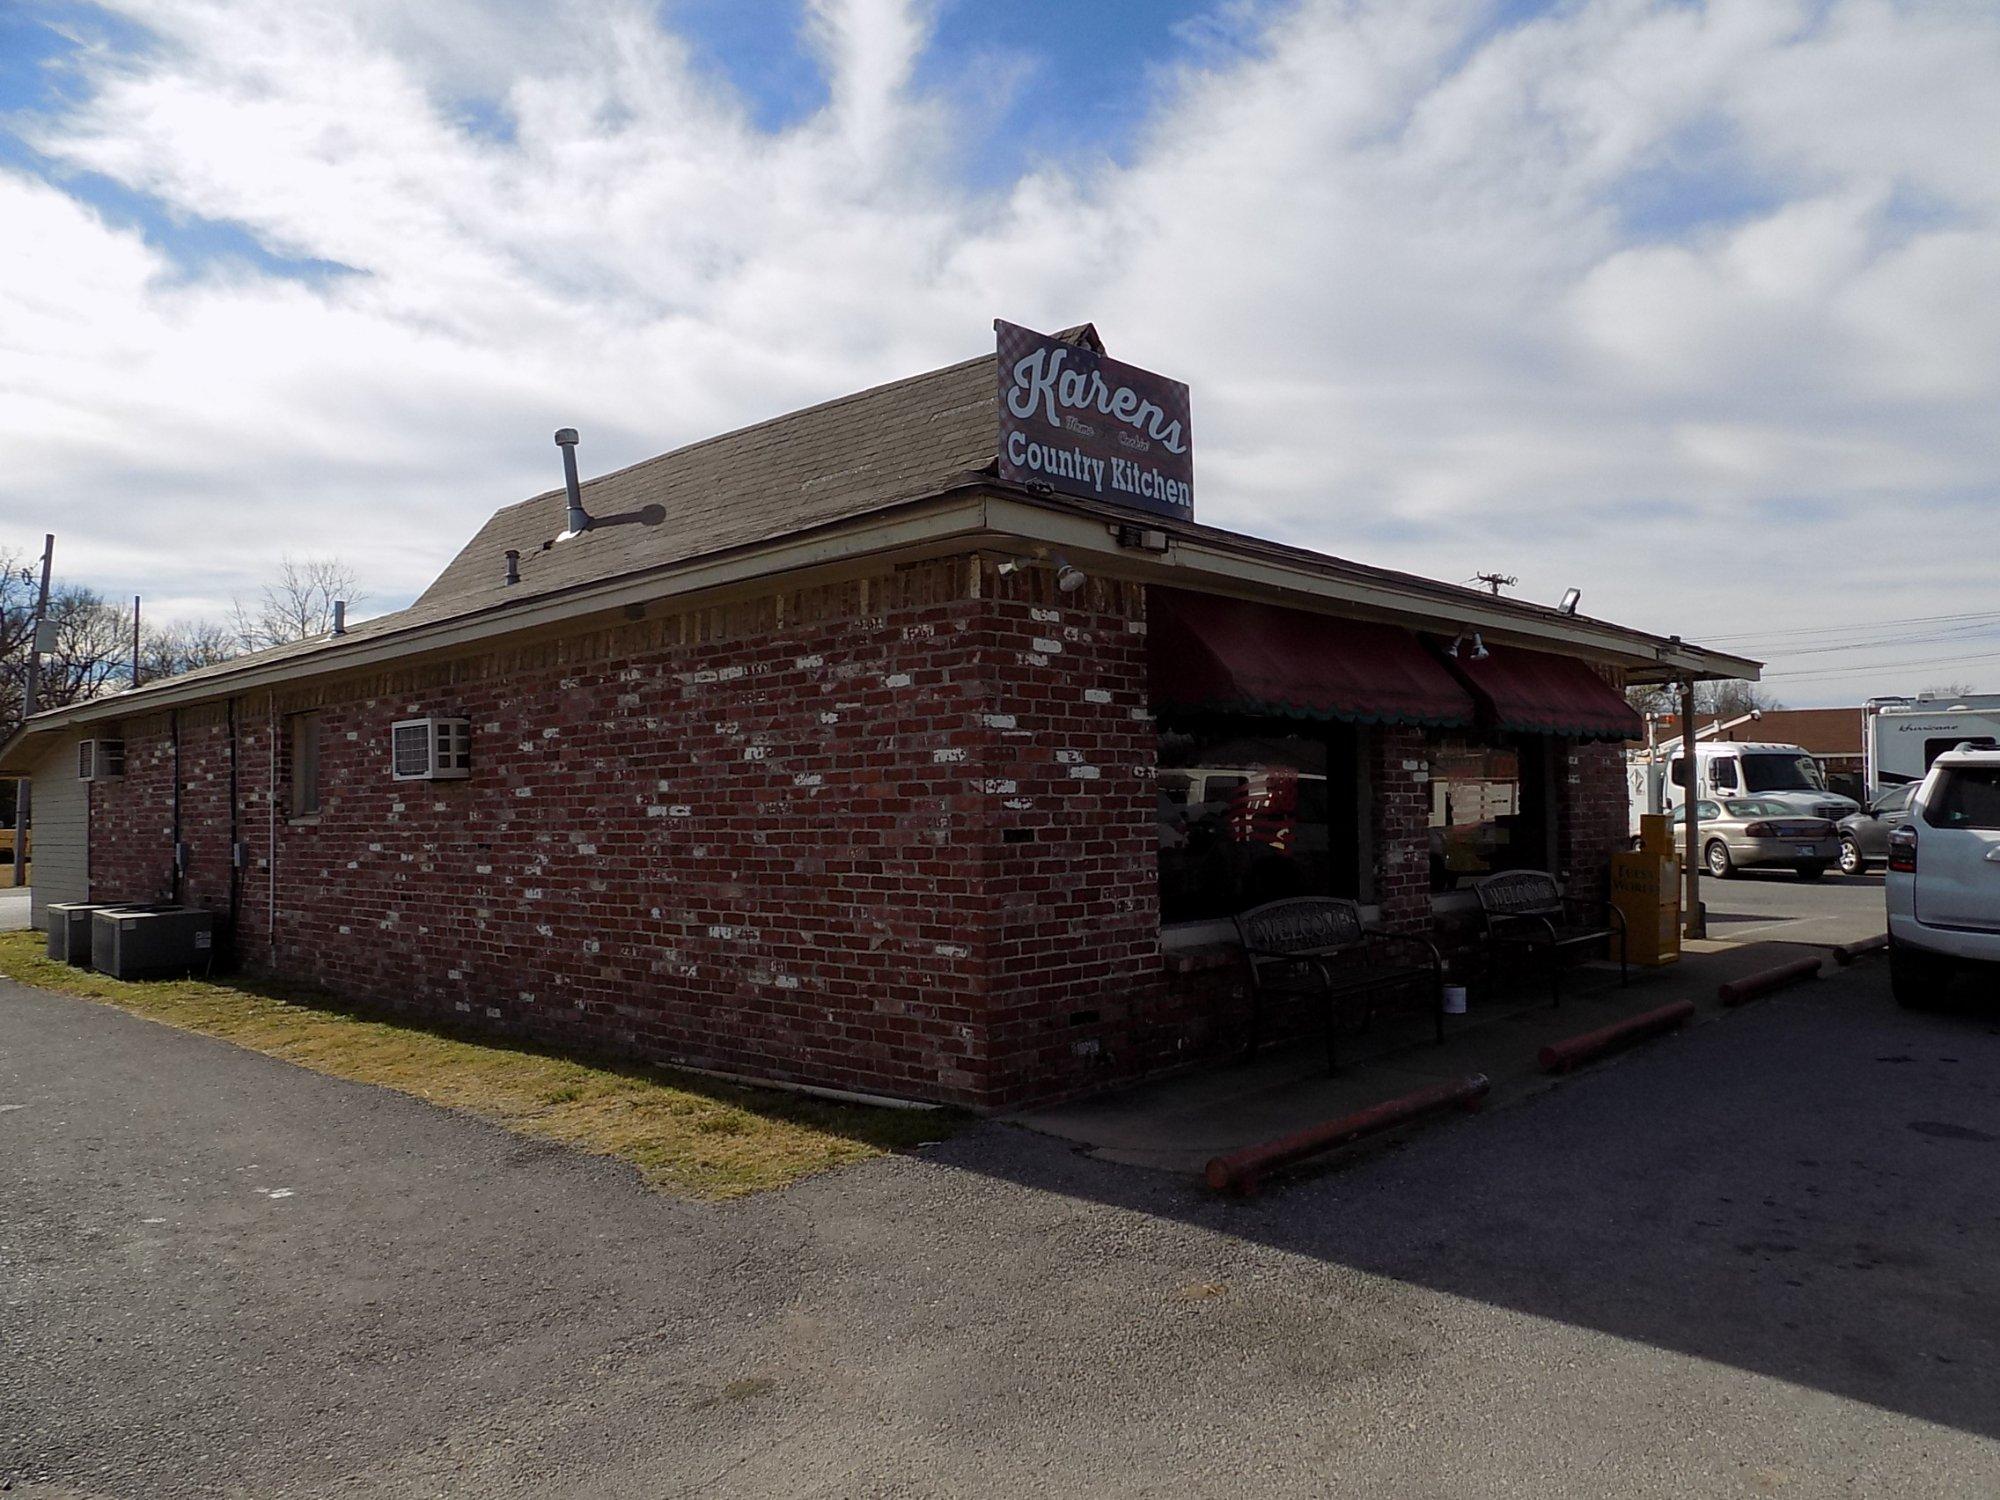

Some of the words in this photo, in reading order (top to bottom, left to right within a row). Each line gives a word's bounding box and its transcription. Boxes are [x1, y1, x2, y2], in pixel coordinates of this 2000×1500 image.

[1007, 348, 1187, 454] Karens
[1007, 431, 1105, 492] Country
[1110, 456, 1191, 507] Kitchen
[1255, 909, 1356, 943] WELCOME
